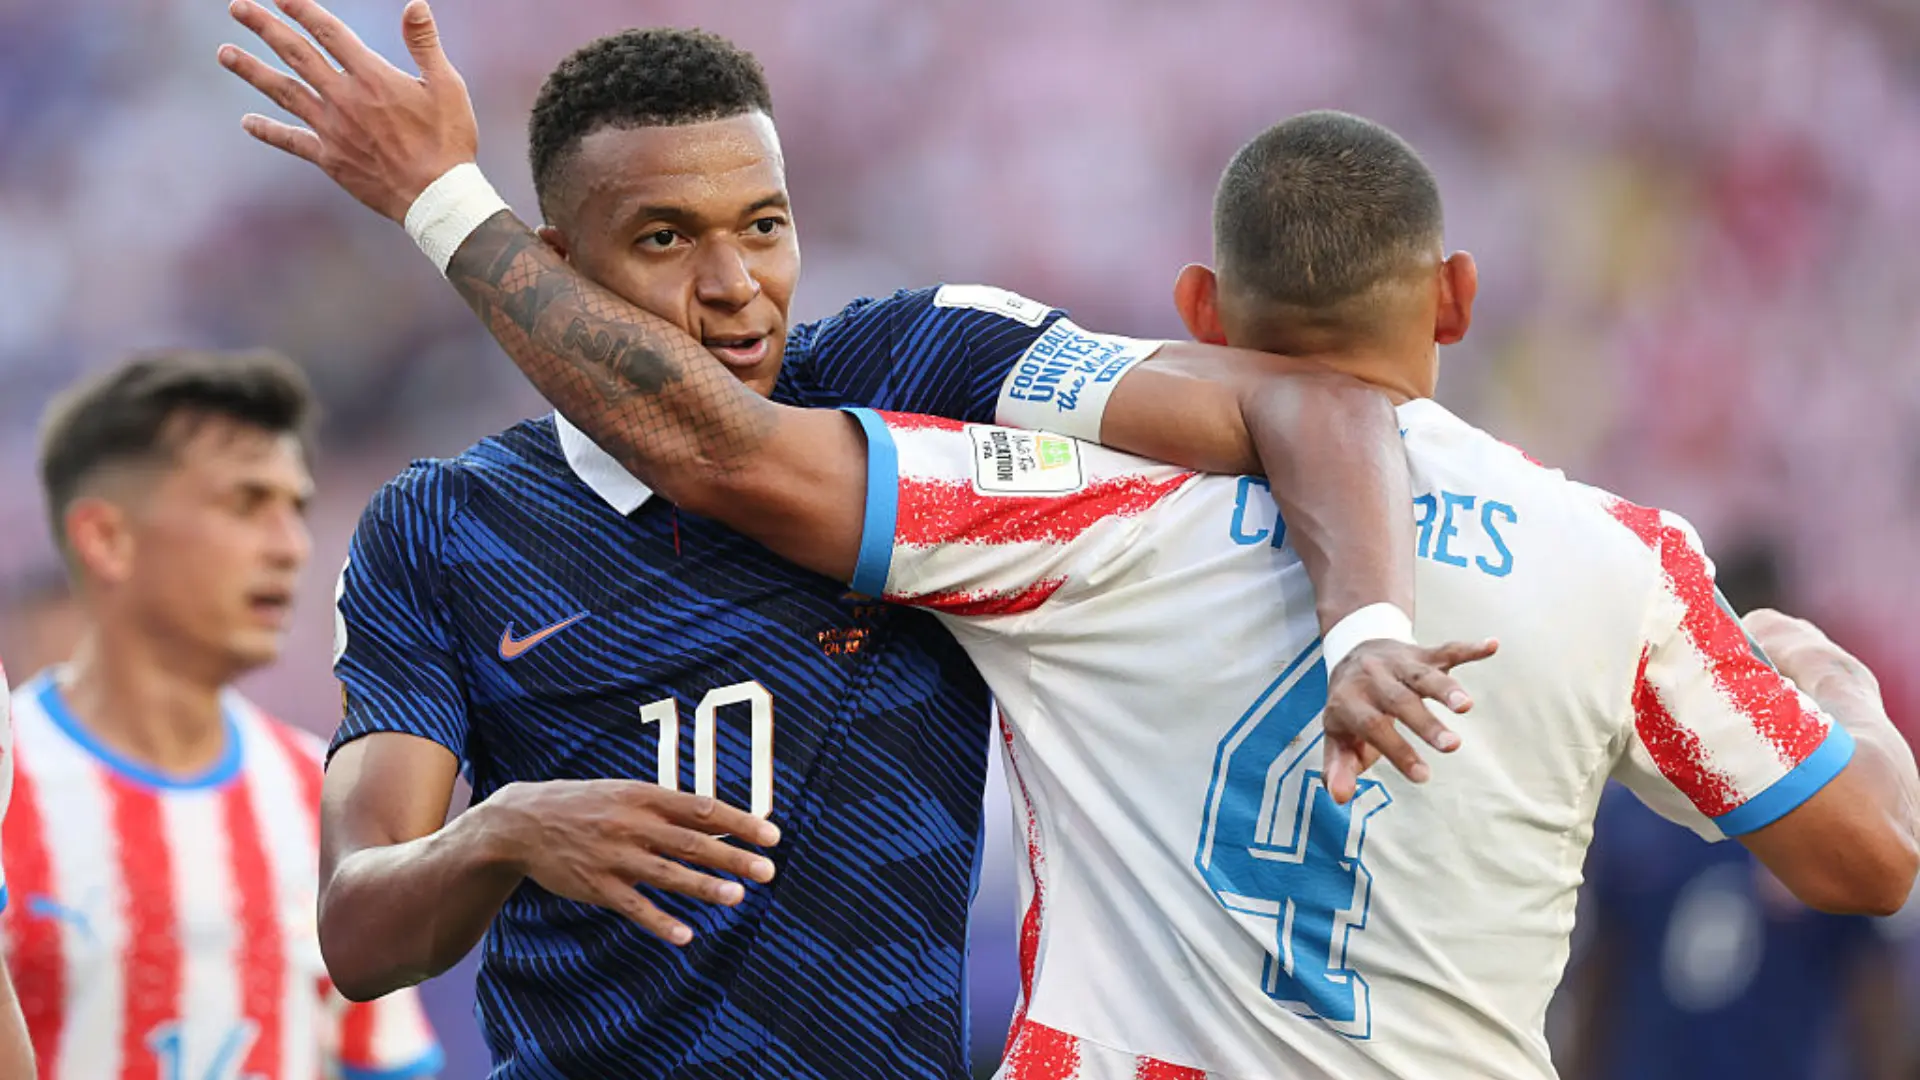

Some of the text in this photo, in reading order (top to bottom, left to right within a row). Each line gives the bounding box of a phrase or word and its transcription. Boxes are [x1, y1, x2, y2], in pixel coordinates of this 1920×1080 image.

[1009, 324, 1075, 400] FOOTBALL
[1027, 334, 1100, 402] UNITES
[1056, 376, 1087, 413] the
[990, 431, 1013, 481] EDUCATION
[1229, 474, 1518, 577] CRES
[639, 680, 774, 830] 10
[1195, 636, 1393, 1041] 4
